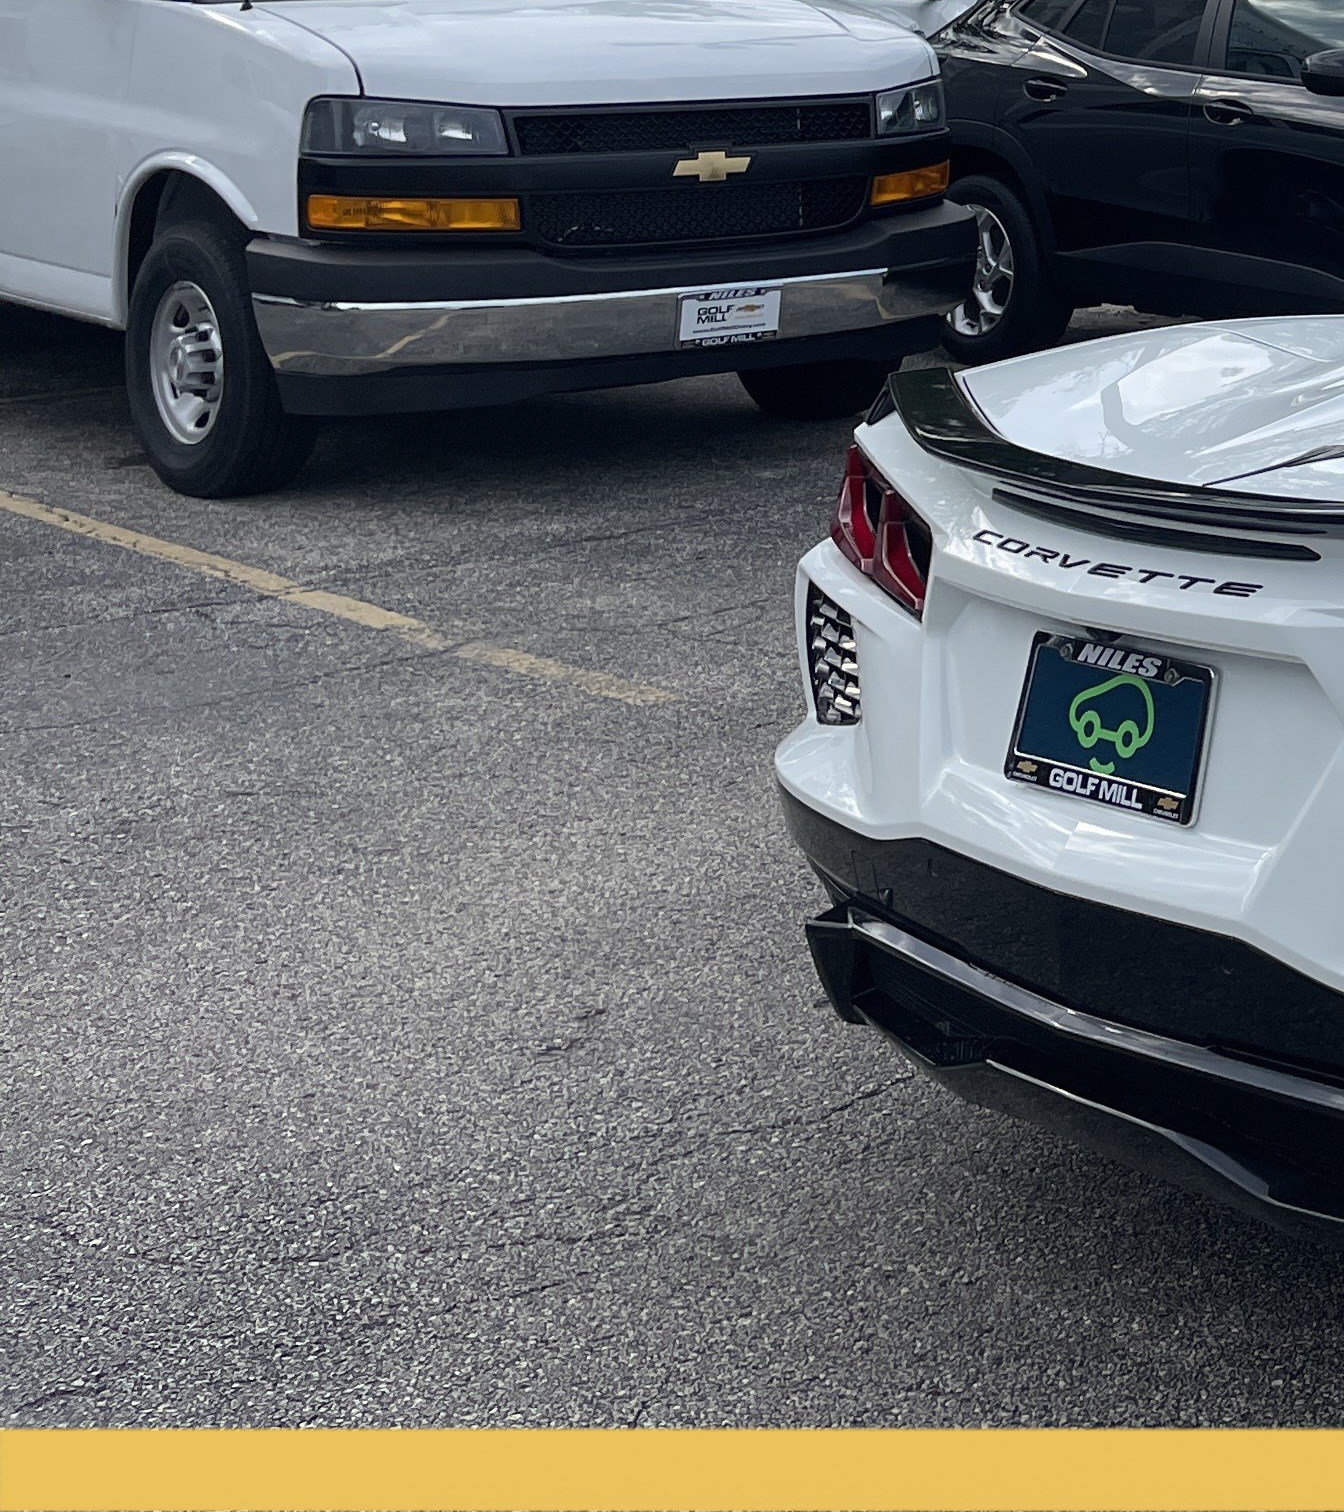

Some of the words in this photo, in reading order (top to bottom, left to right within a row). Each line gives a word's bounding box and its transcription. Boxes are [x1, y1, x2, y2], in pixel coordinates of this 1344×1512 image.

[696, 313, 727, 324] MILL
[697, 304, 735, 315] GOLF
[972, 529, 1264, 598] CORVETTE
[1077, 643, 1163, 677] NILES
[1049, 767, 1100, 796] GOLF
[1098, 782, 1144, 810] MILL
